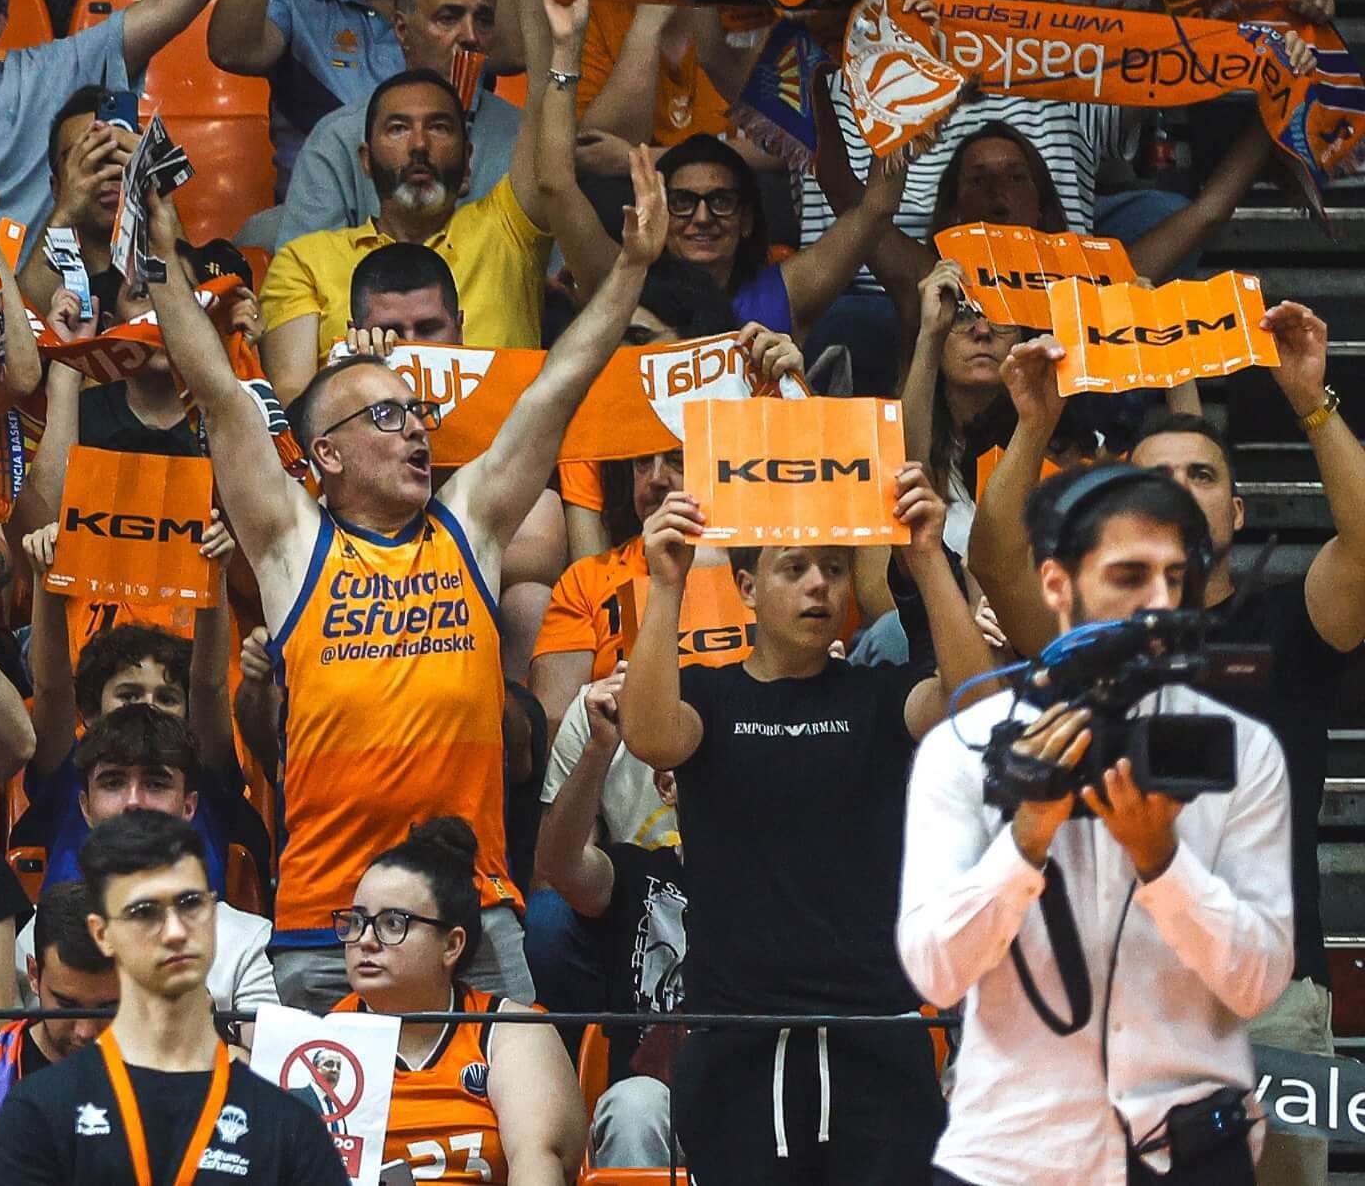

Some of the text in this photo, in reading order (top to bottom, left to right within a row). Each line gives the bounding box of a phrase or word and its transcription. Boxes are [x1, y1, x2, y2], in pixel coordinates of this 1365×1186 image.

[1077, 313, 1236, 346] KGM
[717, 458, 870, 484] KGM
[65, 507, 205, 545] KGM
[329, 568, 463, 602] Cultura del
[322, 596, 470, 638] Esfuerzo
[319, 634, 476, 665] @ValenciaBasket
[733, 719, 850, 735] EMPORIO ARMANI
